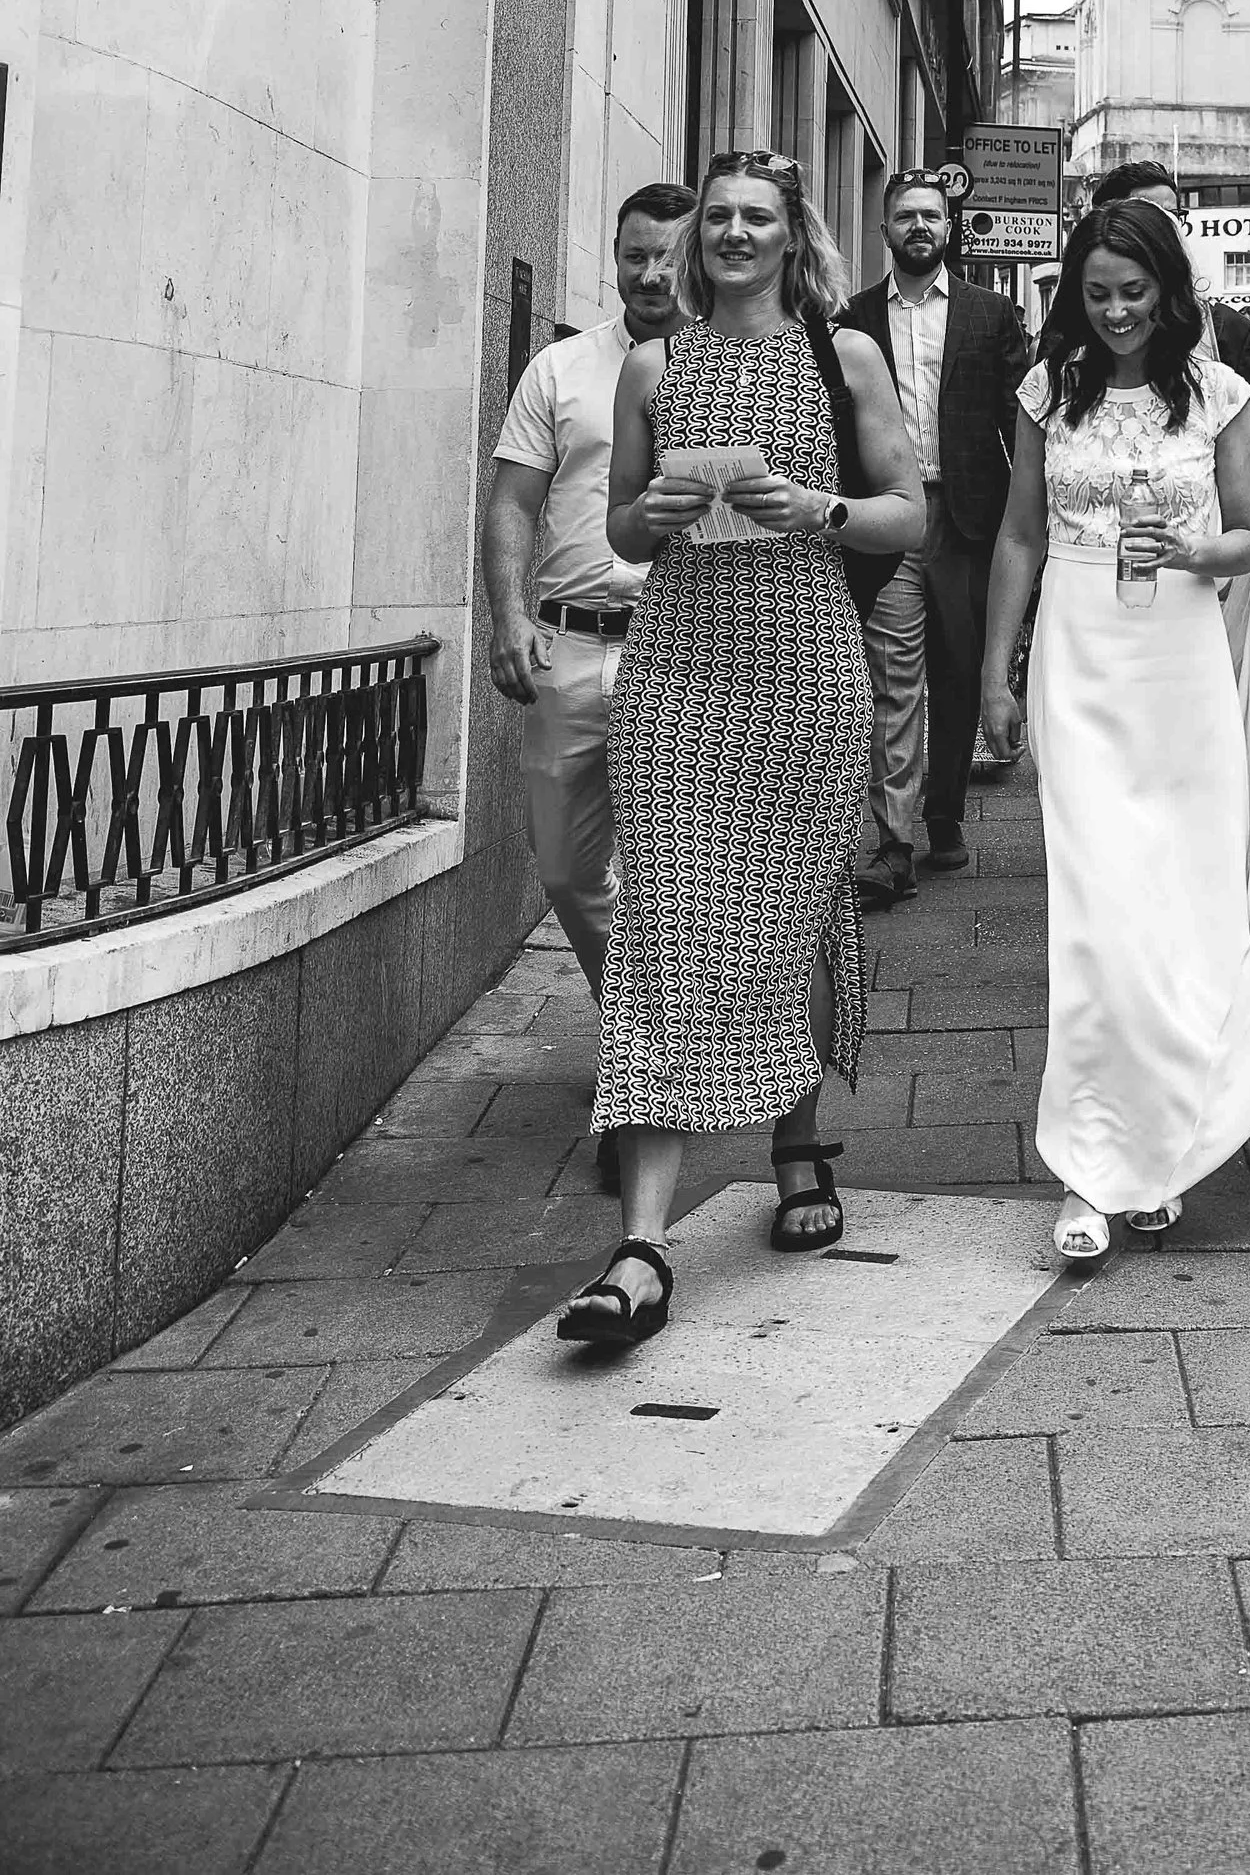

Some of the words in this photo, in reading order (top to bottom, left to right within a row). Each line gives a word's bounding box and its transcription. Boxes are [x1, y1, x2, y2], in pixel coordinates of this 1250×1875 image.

[965, 137, 1011, 152] OFFICE
[1014, 139, 1031, 153] TO
[1034, 140, 1057, 155] LET
[999, 160, 1006, 168] to
[940, 171, 968, 188] 20
[994, 215, 1053, 227] BURSTON
[1005, 226, 1041, 236] COOK
[1003, 238, 1023, 248] 934
[1027, 239, 1053, 249] 9977
